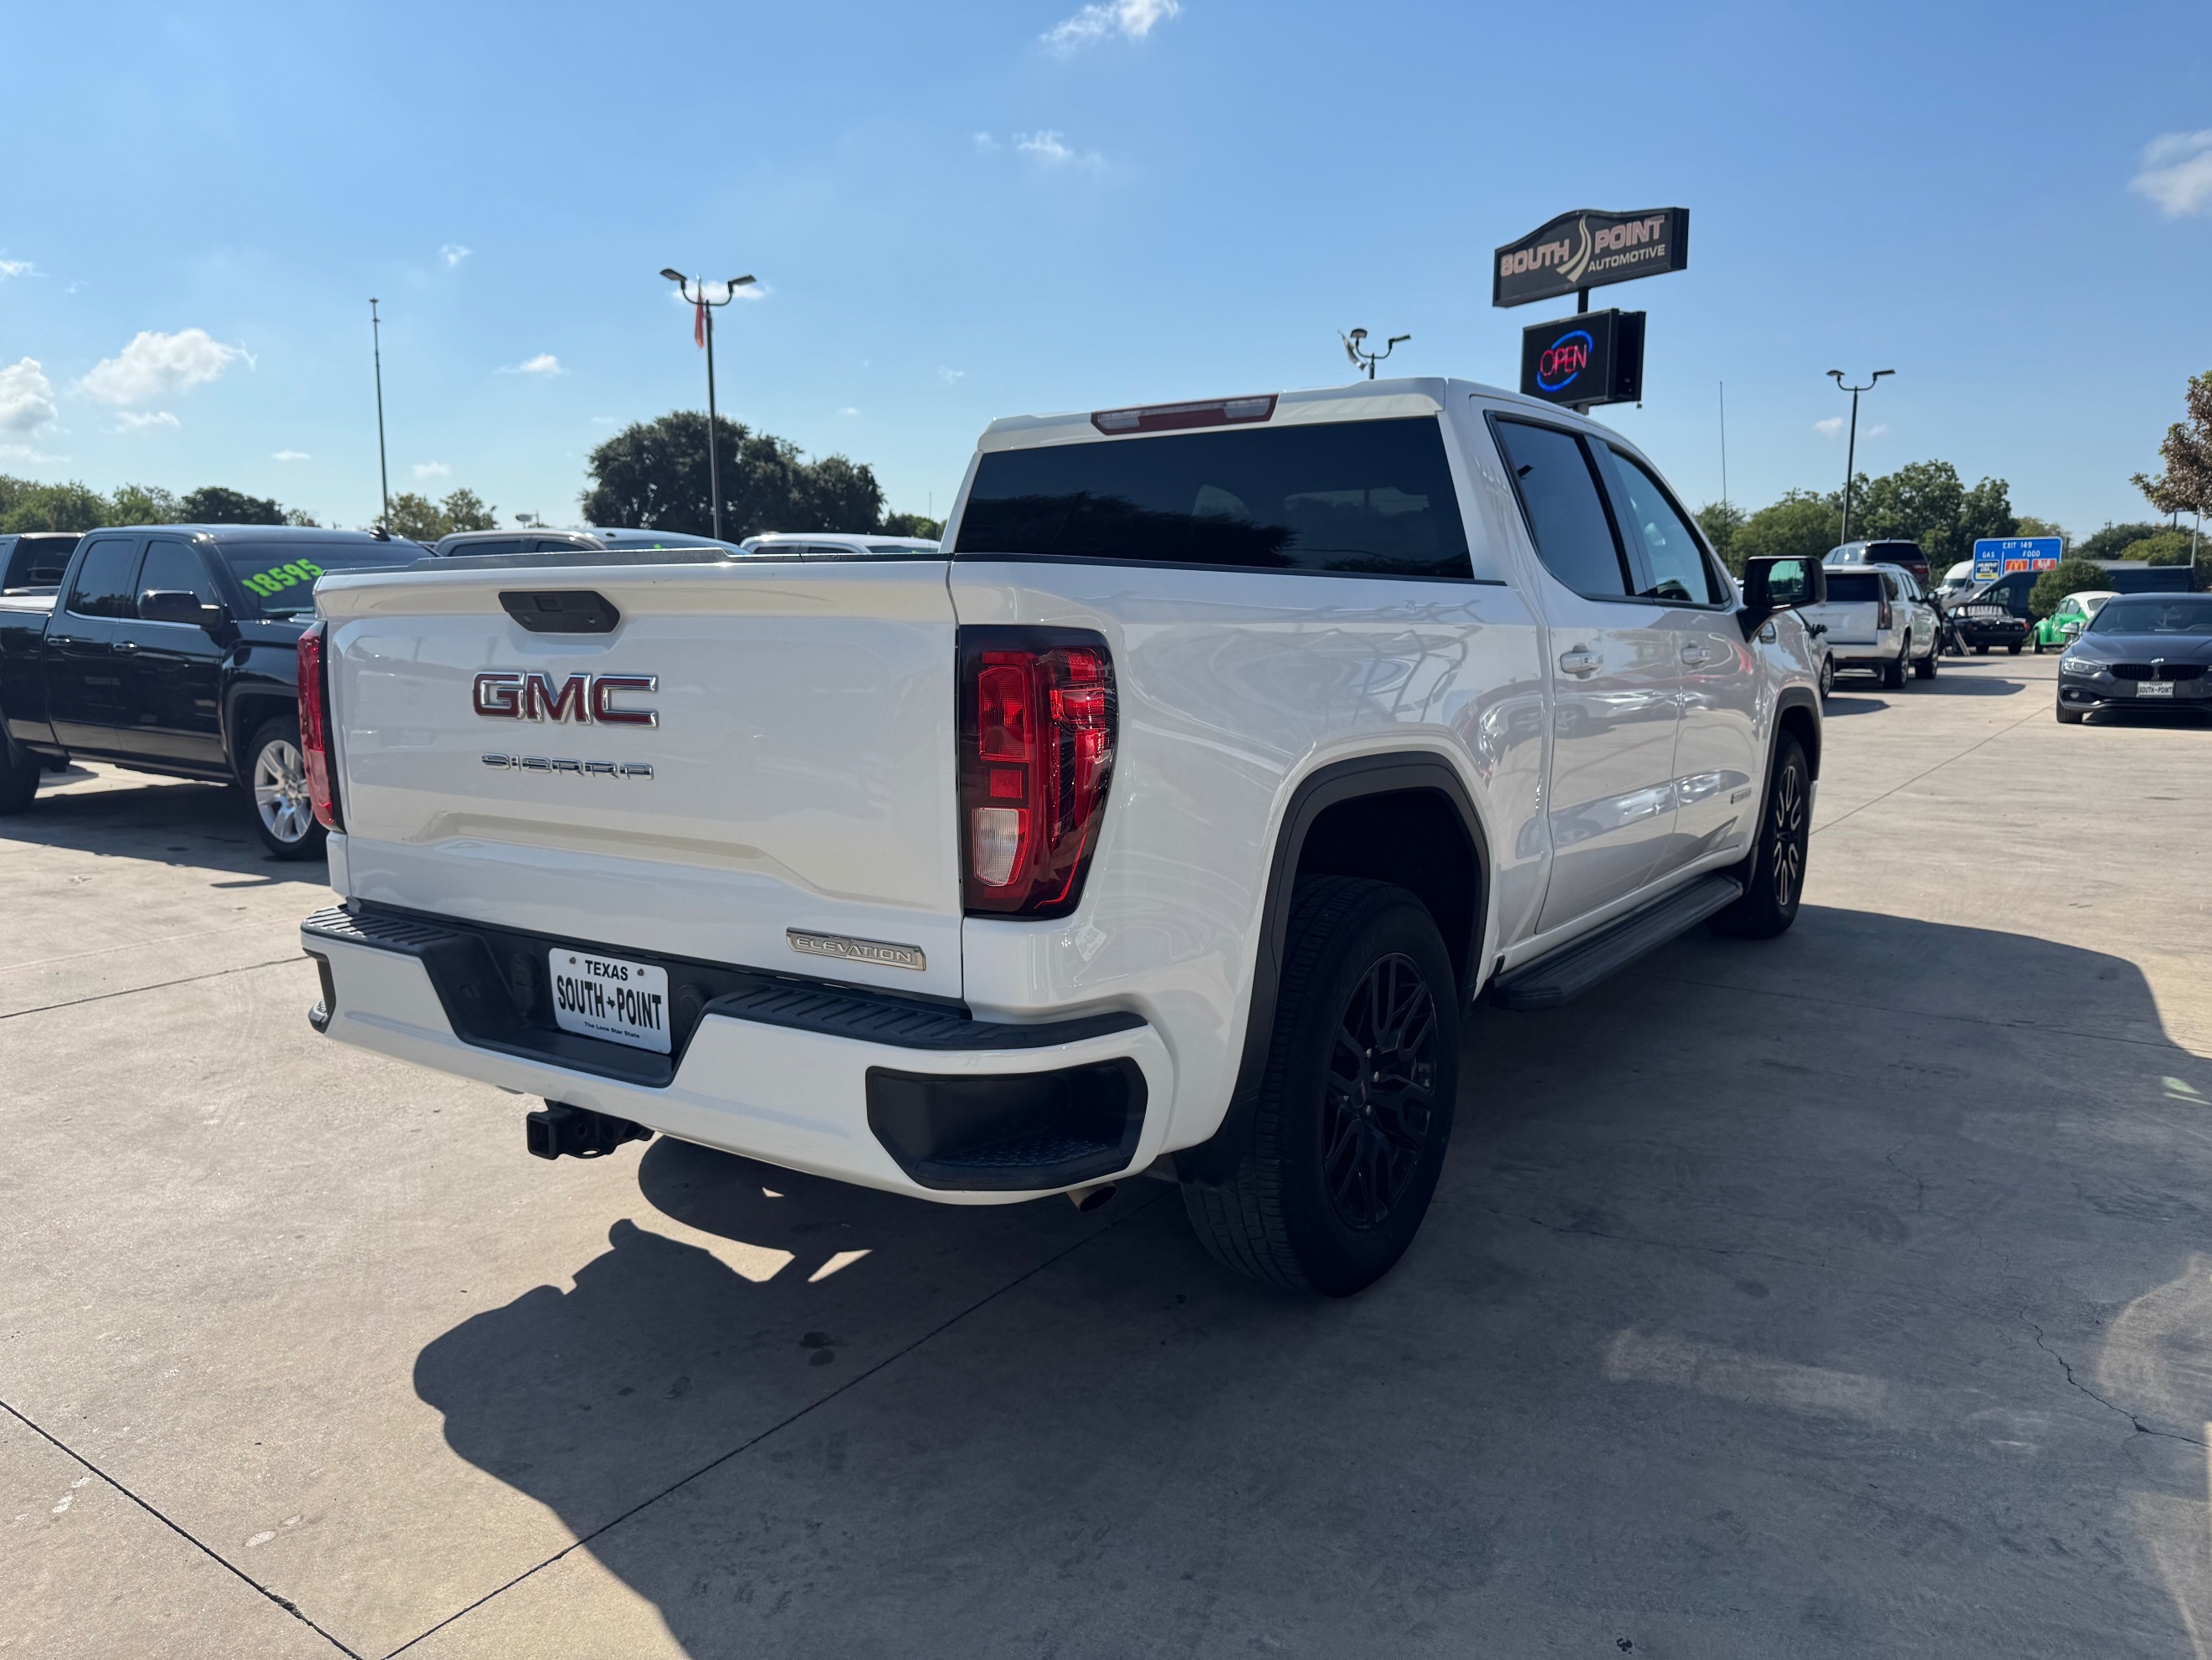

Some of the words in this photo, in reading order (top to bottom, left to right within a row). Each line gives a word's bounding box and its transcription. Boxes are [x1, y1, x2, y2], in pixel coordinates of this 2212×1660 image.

[1501, 238, 1570, 277] SOUTH
[1594, 214, 1665, 254] POINT
[1588, 244, 1665, 272] AUTOMOTIVE
[1540, 343, 1588, 377] OPEN
[2003, 541, 2017, 549] EXIT
[2022, 549, 2040, 558] FOOD
[242, 558, 323, 597] 18595
[473, 671, 659, 728] GMC
[481, 753, 654, 780] SIERRA
[796, 937, 911, 962] ELEVATION
[585, 959, 628, 981] TEXAS
[557, 974, 606, 1019] SOUTH
[616, 987, 661, 1030] POINT
[584, 1020, 595, 1029] The
[596, 1024, 610, 1032] Lone
